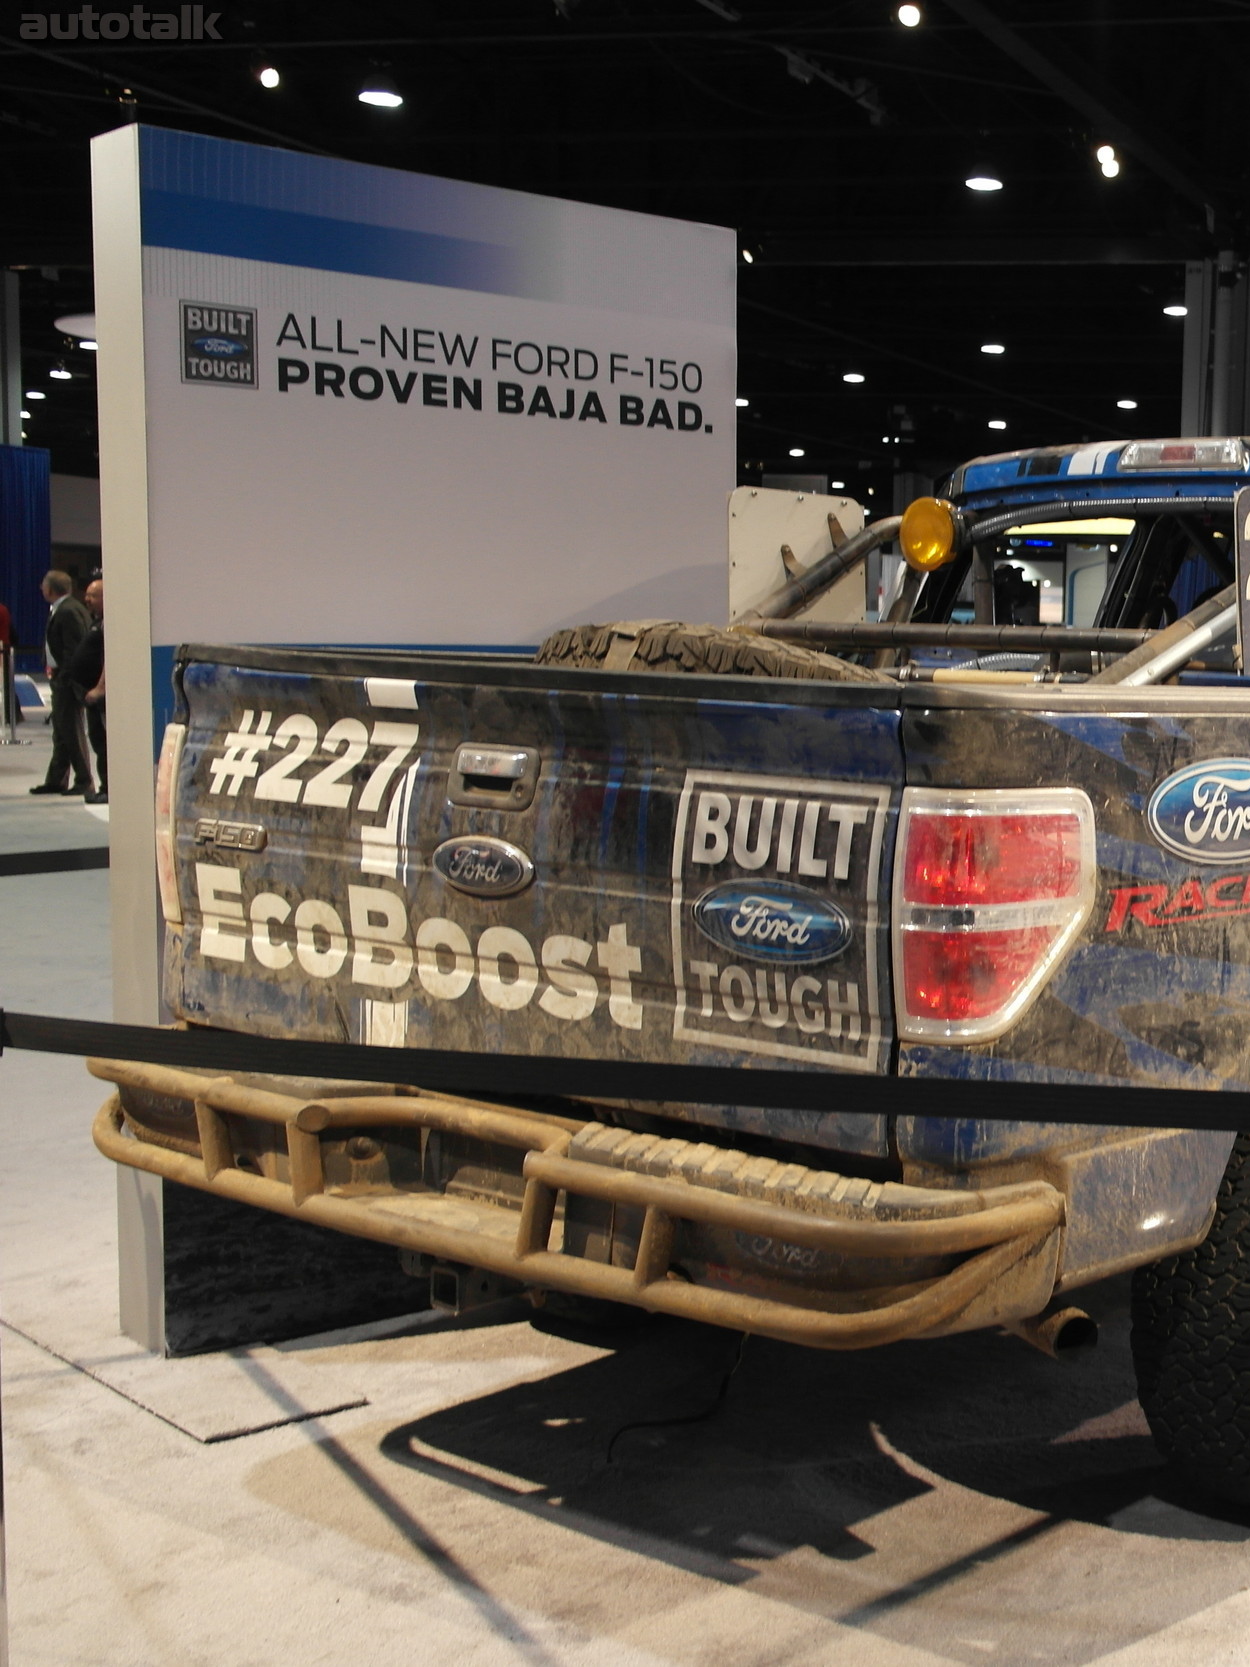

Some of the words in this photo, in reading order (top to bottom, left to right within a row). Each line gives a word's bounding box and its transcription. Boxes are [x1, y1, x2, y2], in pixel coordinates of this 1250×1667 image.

[187, 308, 250, 336] BUILT
[276, 313, 479, 368] ALL-NEW
[492, 338, 598, 381] FORD
[610, 353, 703, 393] F-150
[188, 357, 251, 381] TOUGH
[278, 357, 482, 411] PROVEN
[498, 381, 607, 423] BAJA
[620, 394, 713, 434] BAD.
[209, 709, 419, 812] #227
[449, 846, 503, 884] Ford
[692, 791, 870, 880] BUILT
[195, 862, 644, 1030] EcoBoost
[731, 895, 813, 946] Ford
[690, 960, 862, 1041] TOUGH
